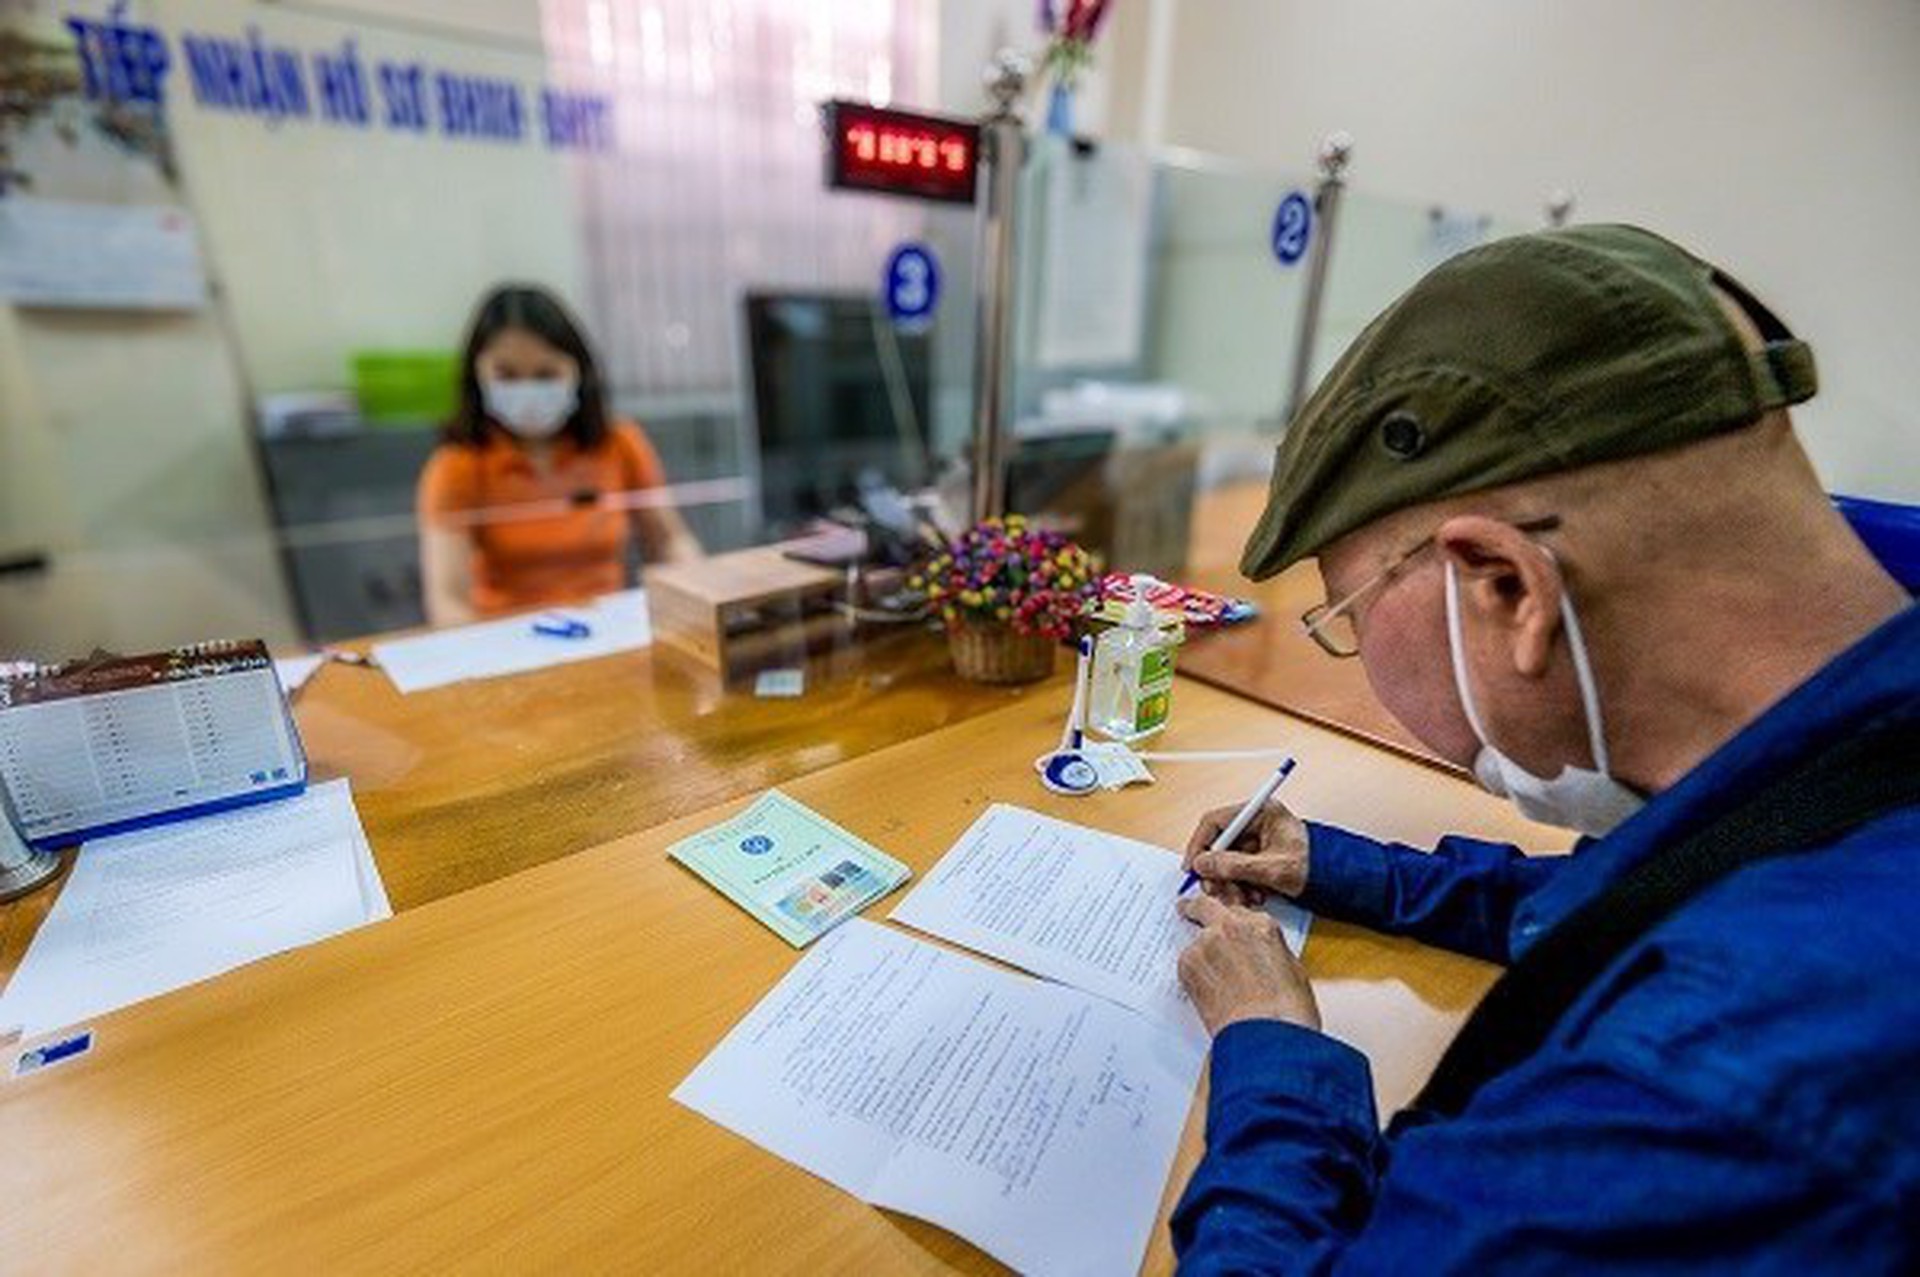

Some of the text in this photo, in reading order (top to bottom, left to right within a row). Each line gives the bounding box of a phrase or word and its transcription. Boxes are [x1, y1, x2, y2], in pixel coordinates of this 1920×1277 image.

[67, 2, 169, 104] TIẾP
[183, 24, 309, 129] NHẬN
[1282, 202, 1303, 255] 2
[896, 254, 928, 311] 3
